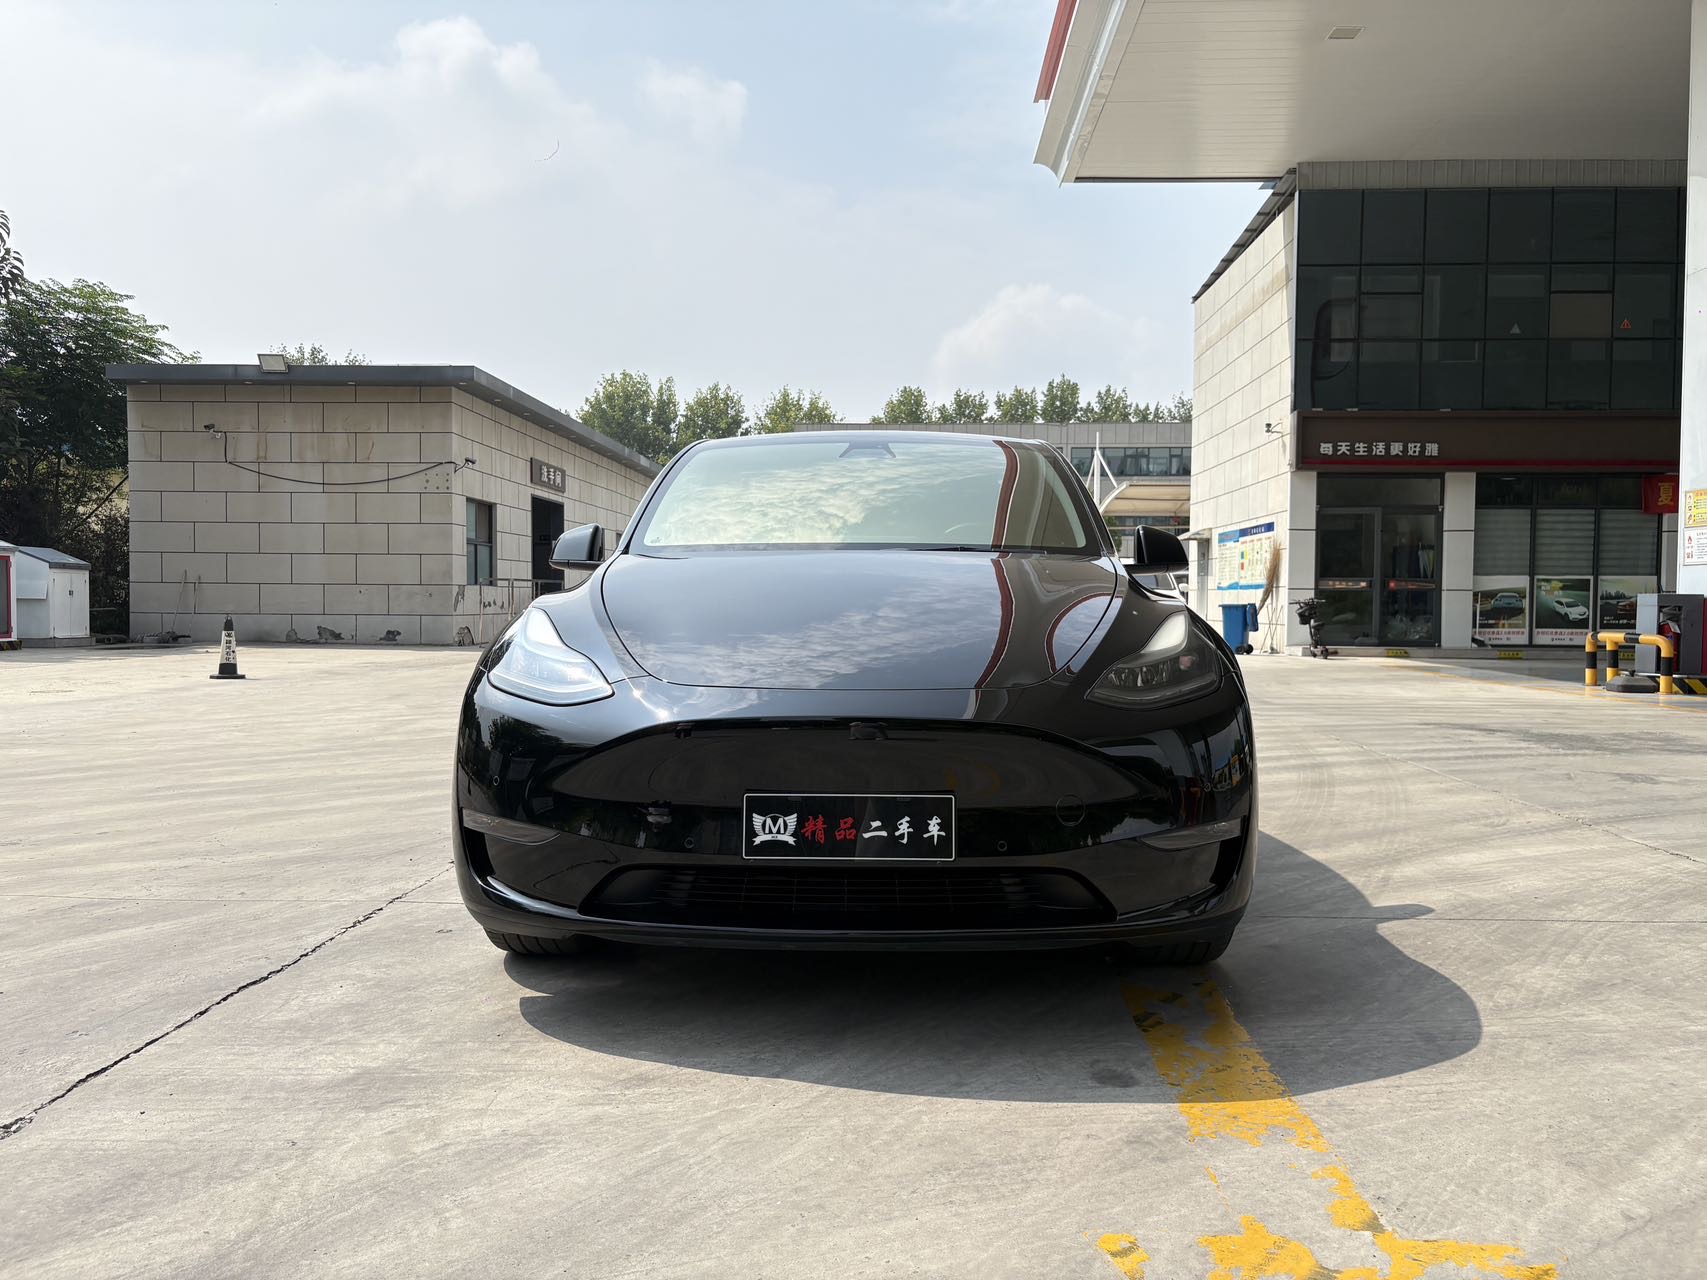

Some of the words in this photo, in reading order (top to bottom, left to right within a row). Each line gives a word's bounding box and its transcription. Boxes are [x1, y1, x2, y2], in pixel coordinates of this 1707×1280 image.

[541, 464, 562, 487] 洗手间
[764, 817, 785, 834] M
[801, 815, 946, 846] 精品二手车
